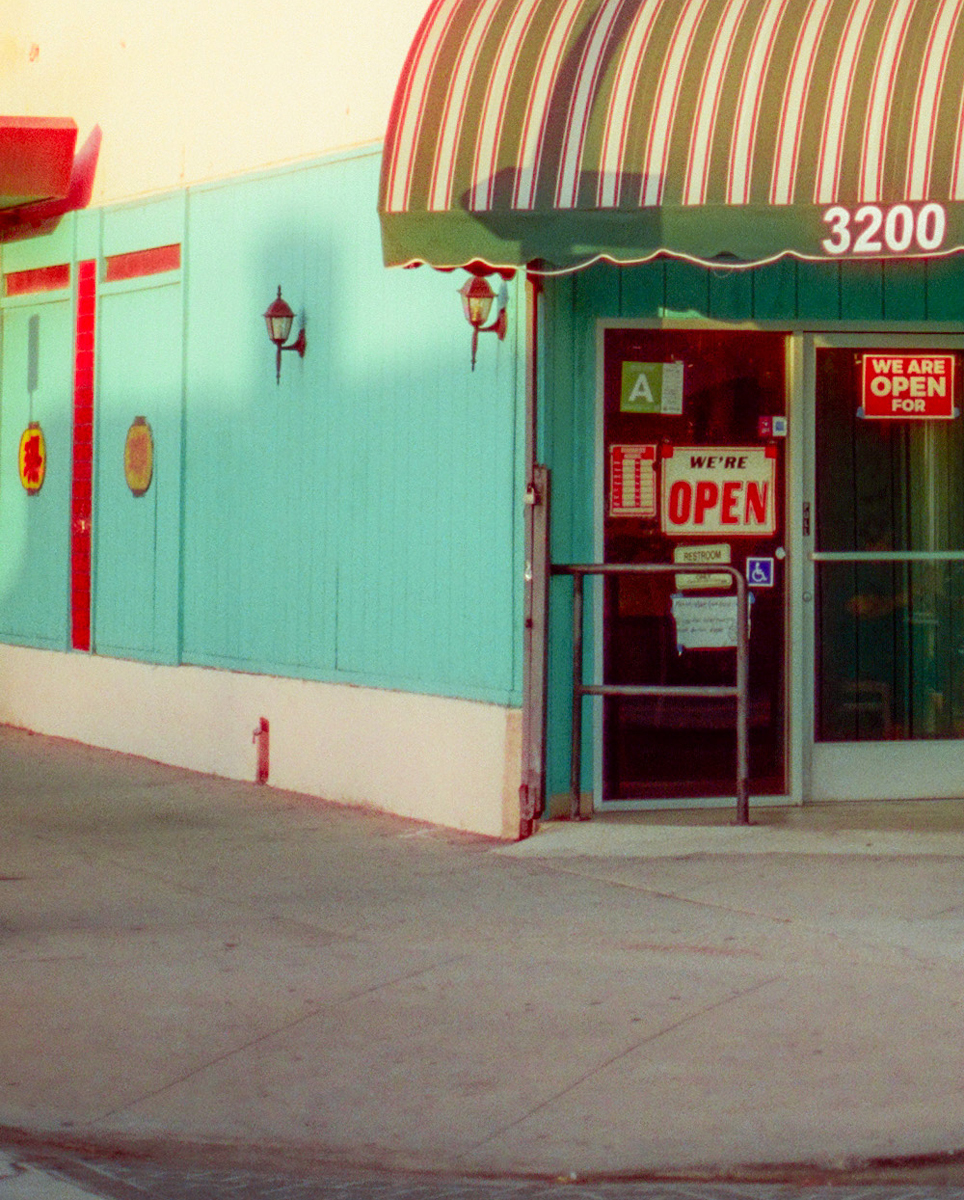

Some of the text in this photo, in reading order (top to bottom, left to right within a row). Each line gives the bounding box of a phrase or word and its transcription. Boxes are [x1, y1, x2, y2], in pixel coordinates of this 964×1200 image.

[821, 202, 946, 255] 3200
[872, 358, 946, 375] WE ARE
[627, 372, 655, 403] A
[870, 376, 947, 398] OPEN
[891, 398, 926, 413] FOR
[689, 455, 749, 470] WE'RE
[667, 480, 768, 526] OPEN
